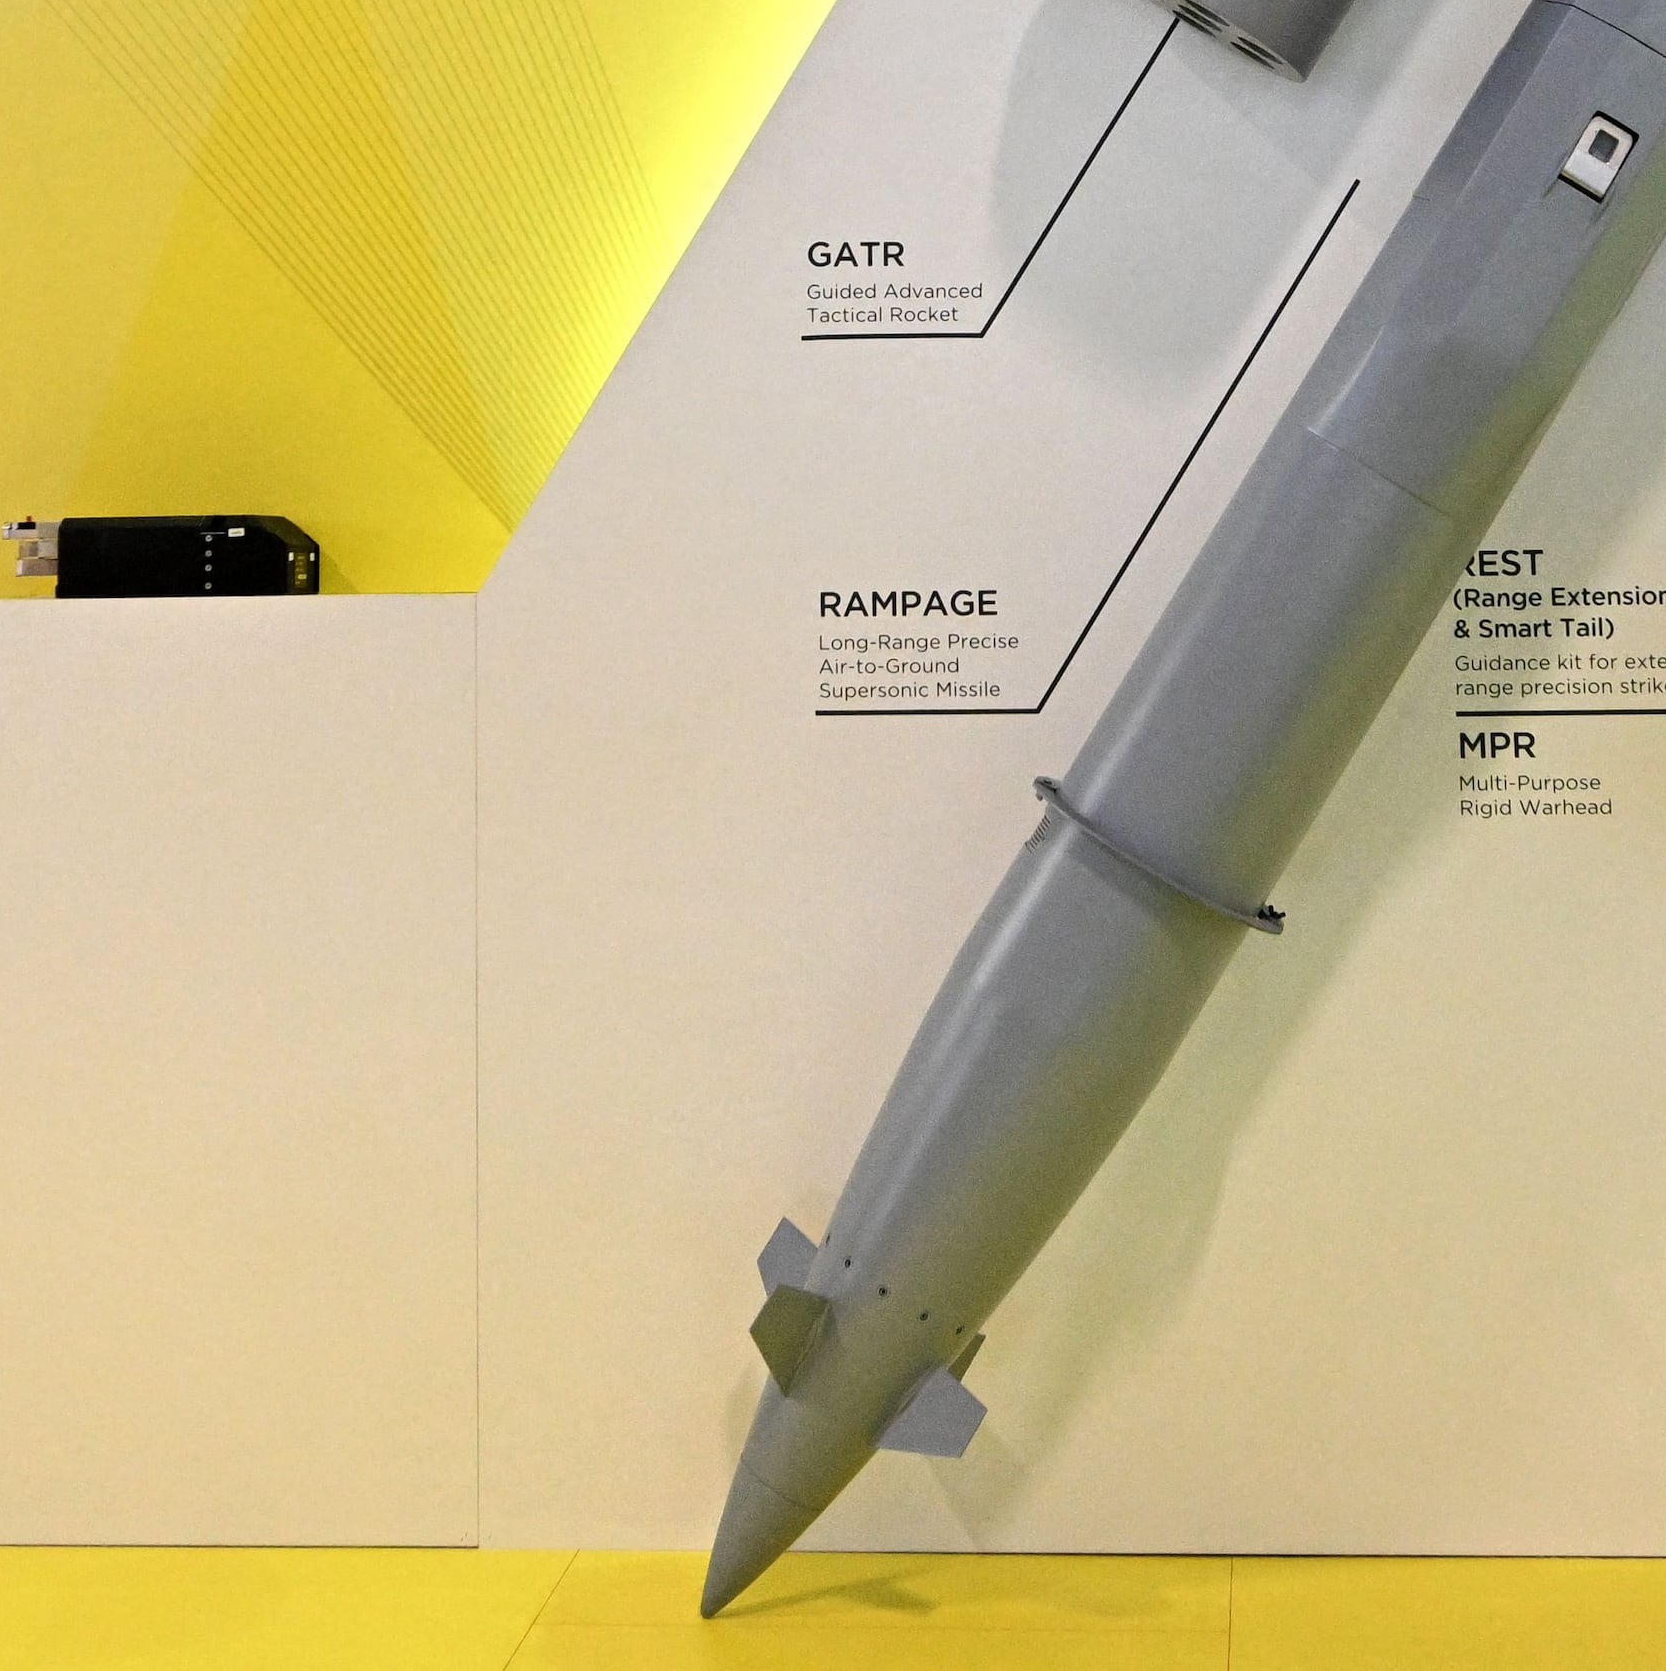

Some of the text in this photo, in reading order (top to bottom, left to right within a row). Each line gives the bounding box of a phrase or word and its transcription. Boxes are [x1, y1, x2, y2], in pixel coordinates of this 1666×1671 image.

[807, 241, 905, 268] GATR
[807, 282, 983, 300] Guided Advanced
[807, 306, 959, 323] Tactical Rocket
[820, 589, 998, 618] RAMPAGE
[1453, 588, 1543, 611] (Range
[1453, 616, 1614, 640] & Smart Tail)
[819, 633, 1019, 654] Long-Range Precise
[819, 656, 960, 675] Air-to-Ground
[1455, 654, 1551, 672] Guidance
[1557, 654, 1582, 670] kit
[1589, 653, 1617, 670] for
[820, 681, 1001, 702] Supersonic Missile
[1455, 682, 1514, 699] range
[1521, 681, 1613, 699] precision
[1459, 731, 1536, 759] MPR
[1459, 775, 1601, 794] Multi-Purpose
[1460, 798, 1612, 819] Rigid Warhead
